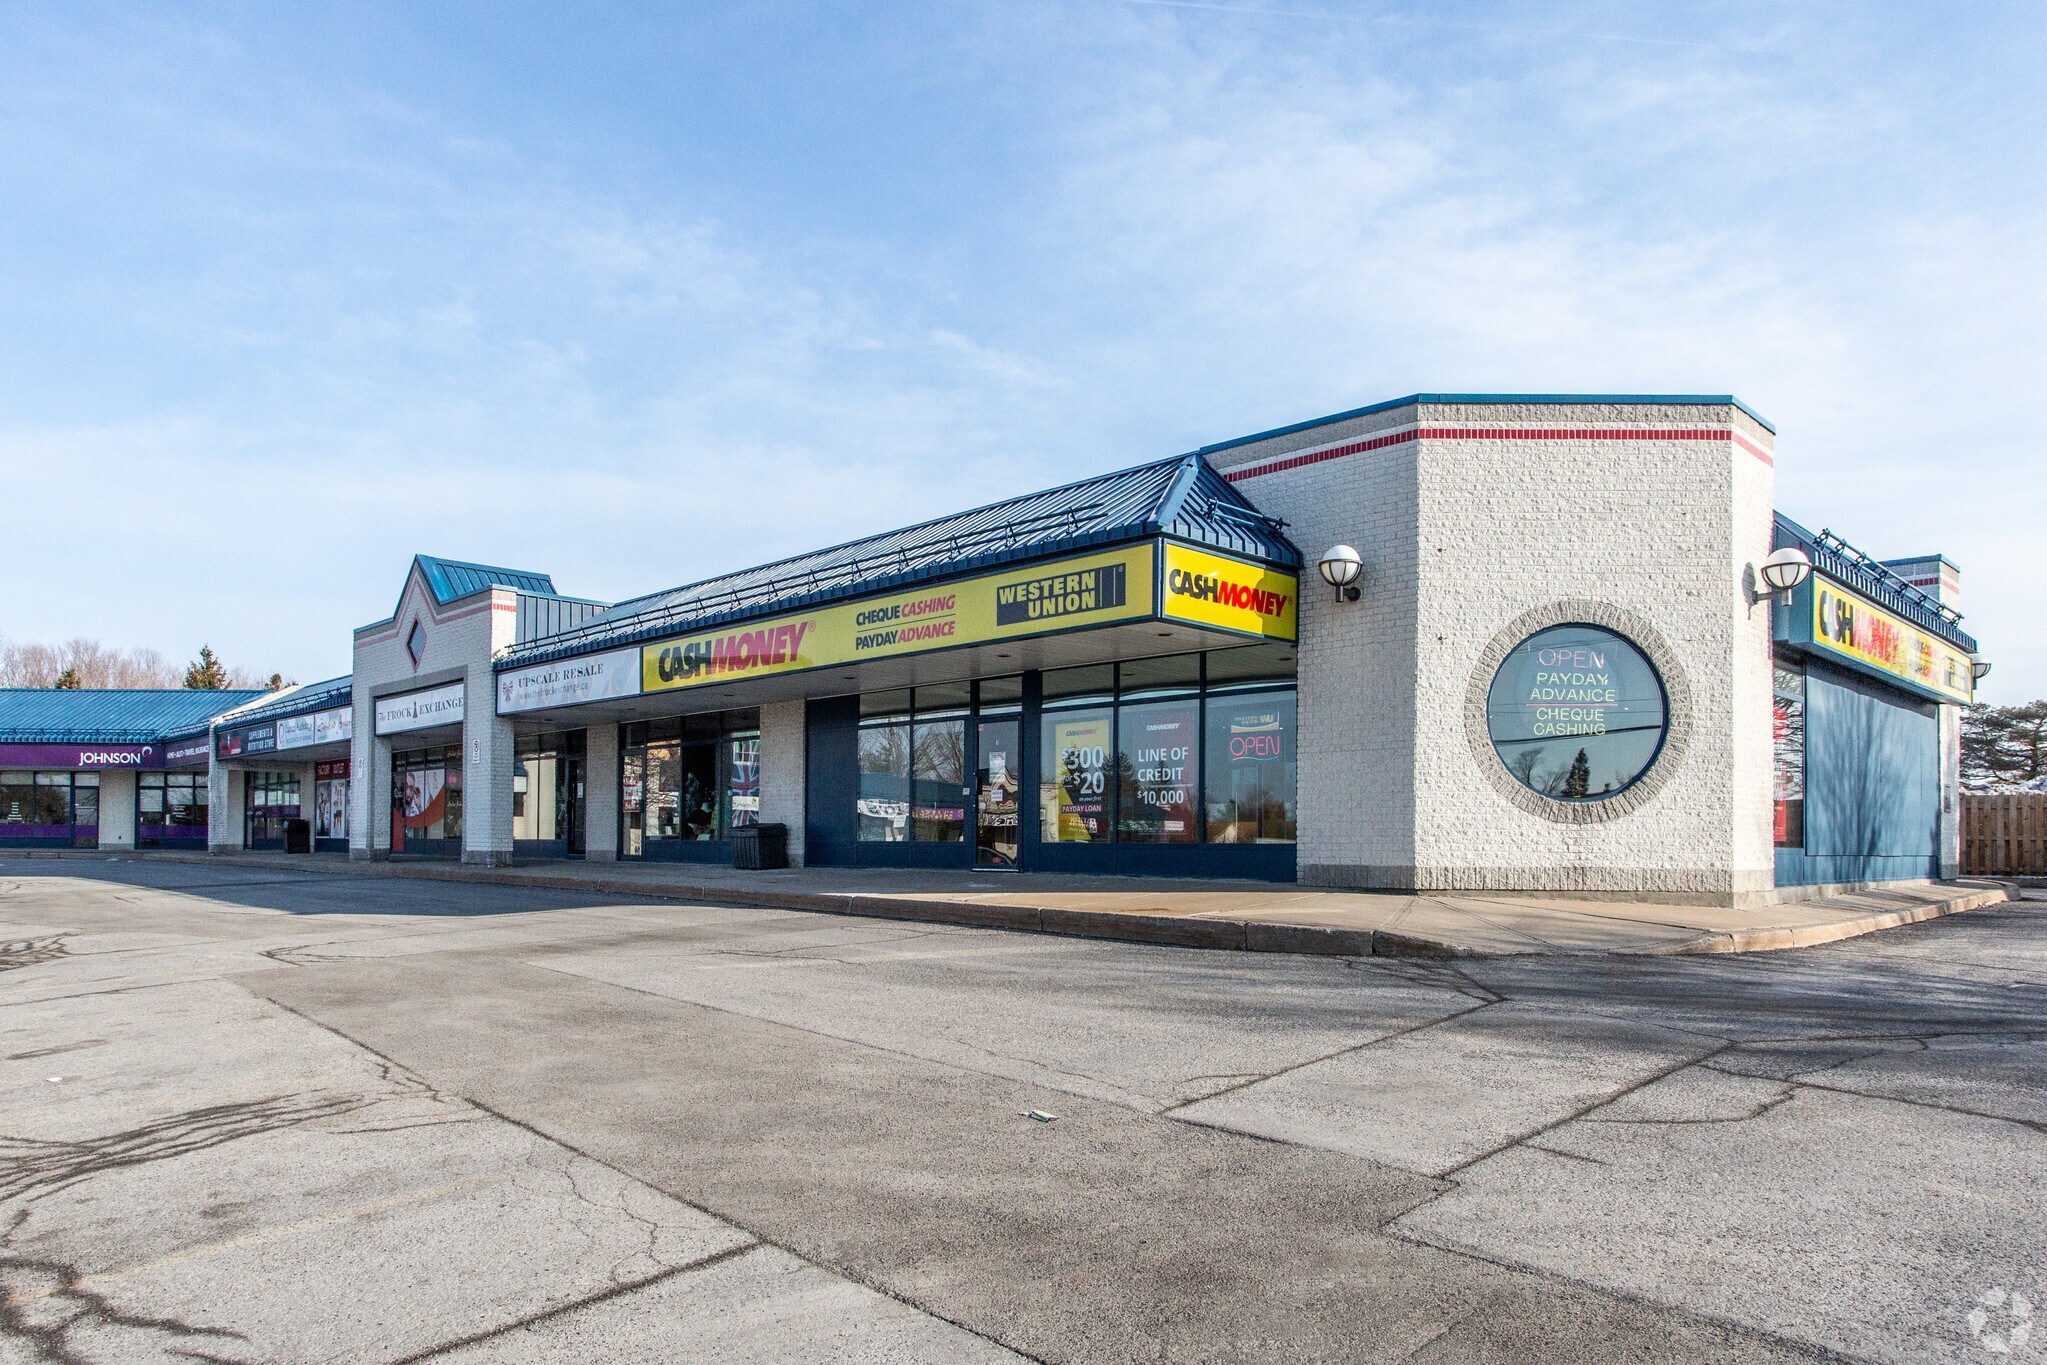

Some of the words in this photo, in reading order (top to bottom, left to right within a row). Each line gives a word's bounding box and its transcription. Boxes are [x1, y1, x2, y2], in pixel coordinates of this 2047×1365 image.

[999, 571, 1096, 605] WESTERN
[856, 605, 900, 626] CHEQUE
[901, 594, 956, 618] CASHING
[1028, 590, 1095, 618] UNION
[855, 630, 898, 650] PAYDAY
[897, 620, 956, 643] ADVANCE
[1538, 648, 1605, 669] OPEN
[518, 671, 560, 687] UPSCALE
[563, 663, 604, 680] RESALE
[1536, 672, 1608, 685] PAYDAY
[1530, 688, 1615, 702] ADVANCE
[387, 707, 412, 720] FROCK
[419, 697, 464, 714] EXCHANGE
[1536, 708, 1604, 722] CHEQUE
[1533, 723, 1606, 736] CASHING
[1138, 748, 1167, 762] LINE
[1170, 747, 1188, 760] OF
[1230, 736, 1280, 756] OPEN
[79, 752, 141, 766] JOHNSON
[1061, 745, 1104, 770] $300
[1073, 771, 1104, 794] $20
[1137, 767, 1184, 782] CREDIT
[1137, 790, 1184, 806] $10,000
[1062, 805, 1084, 813] PAYDAY
[1085, 804, 1102, 812] LOAN
